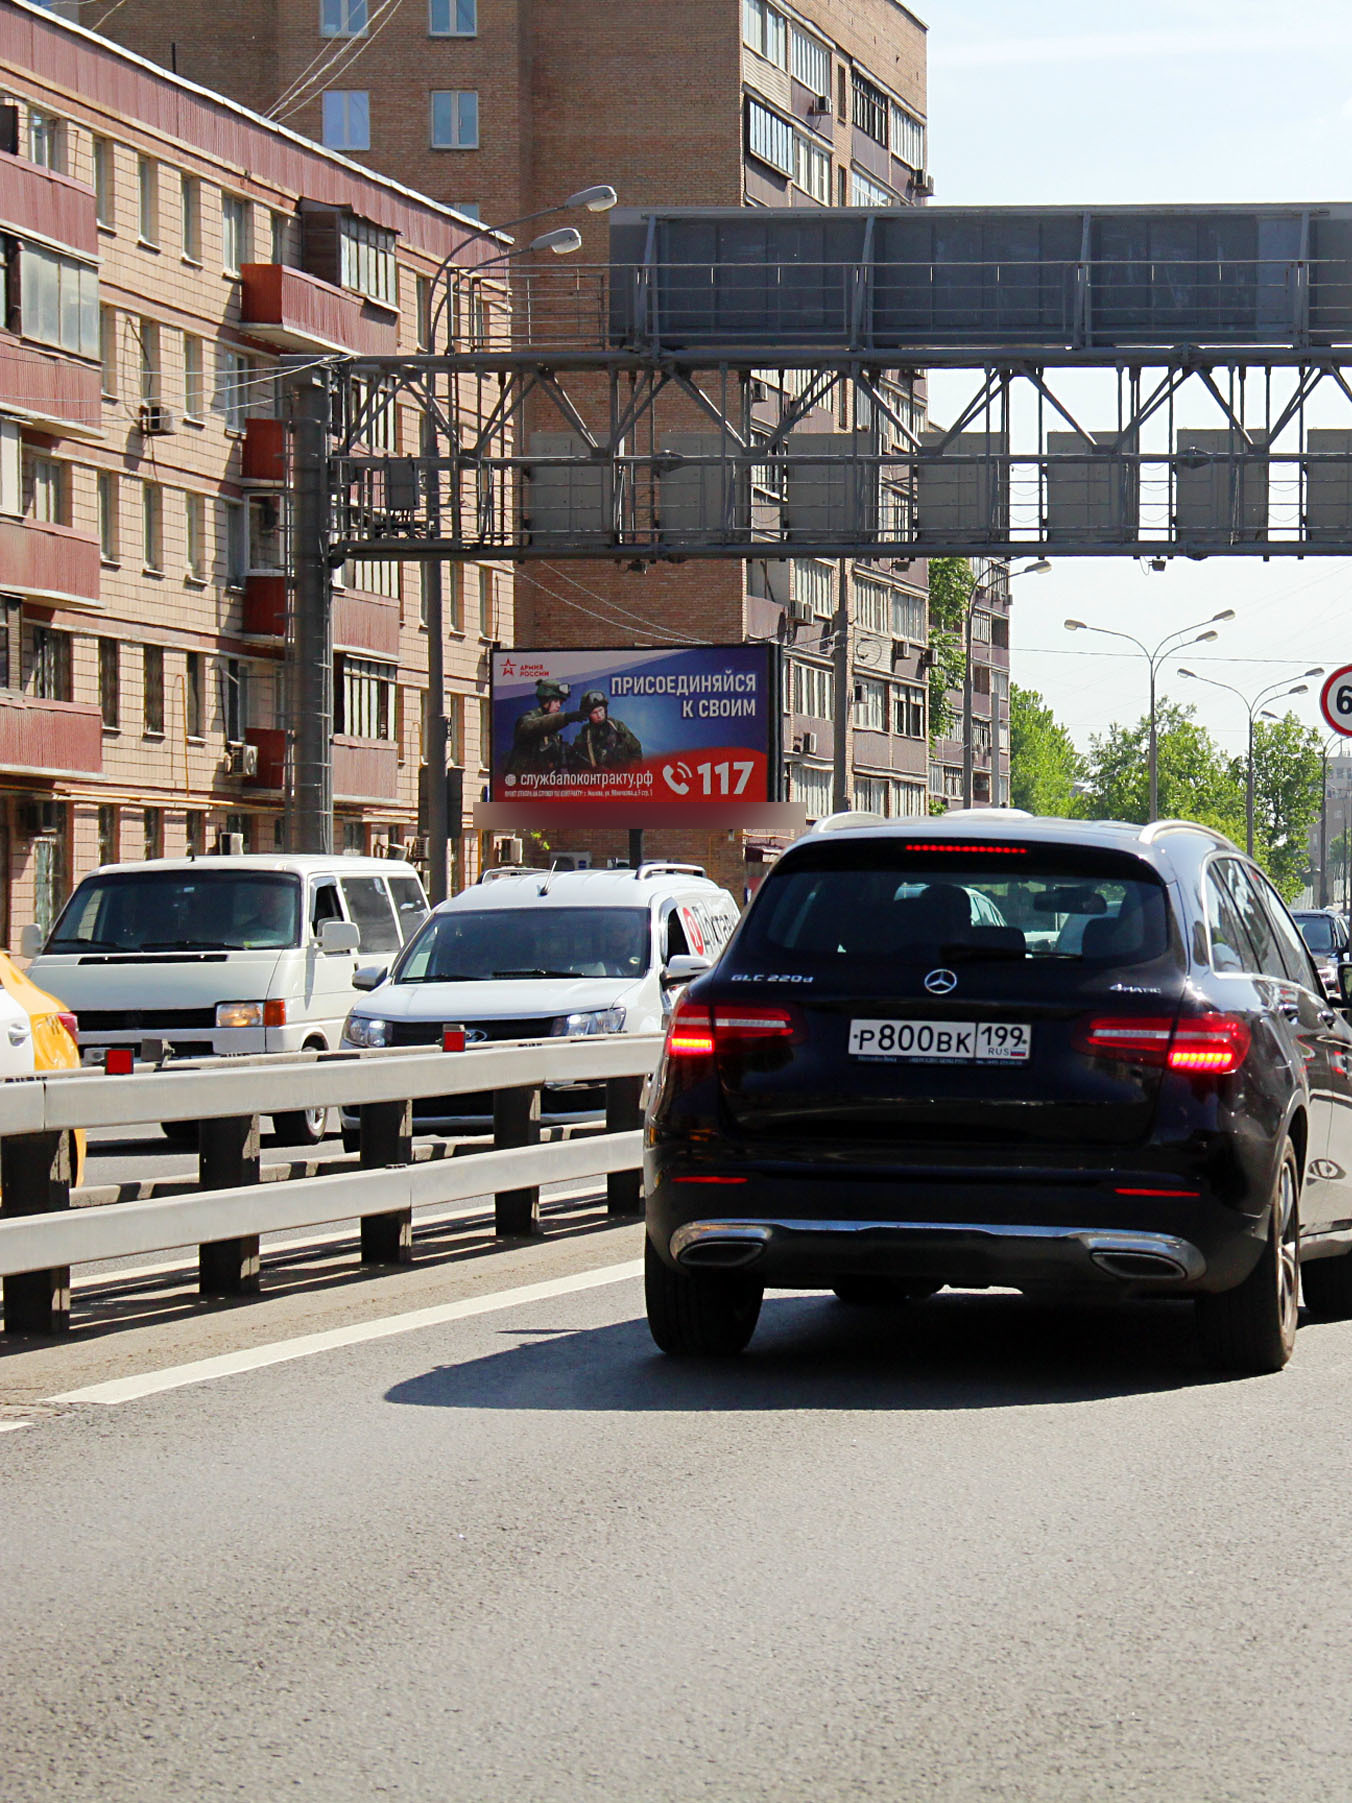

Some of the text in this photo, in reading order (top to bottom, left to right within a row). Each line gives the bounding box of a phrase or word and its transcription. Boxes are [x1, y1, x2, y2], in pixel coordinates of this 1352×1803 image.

[611, 669, 756, 697] ПРИСОЕДИНЯЙСЯ
[682, 698, 756, 718] К СВОИМ
[520, 770, 654, 788] службапоконтракту.рф
[697, 761, 754, 795] 117
[691, 906, 737, 954] Достав
[731, 973, 814, 983] GLC 220d
[981, 1026, 1024, 1047] 199
[988, 1047, 1010, 1056] RUS
